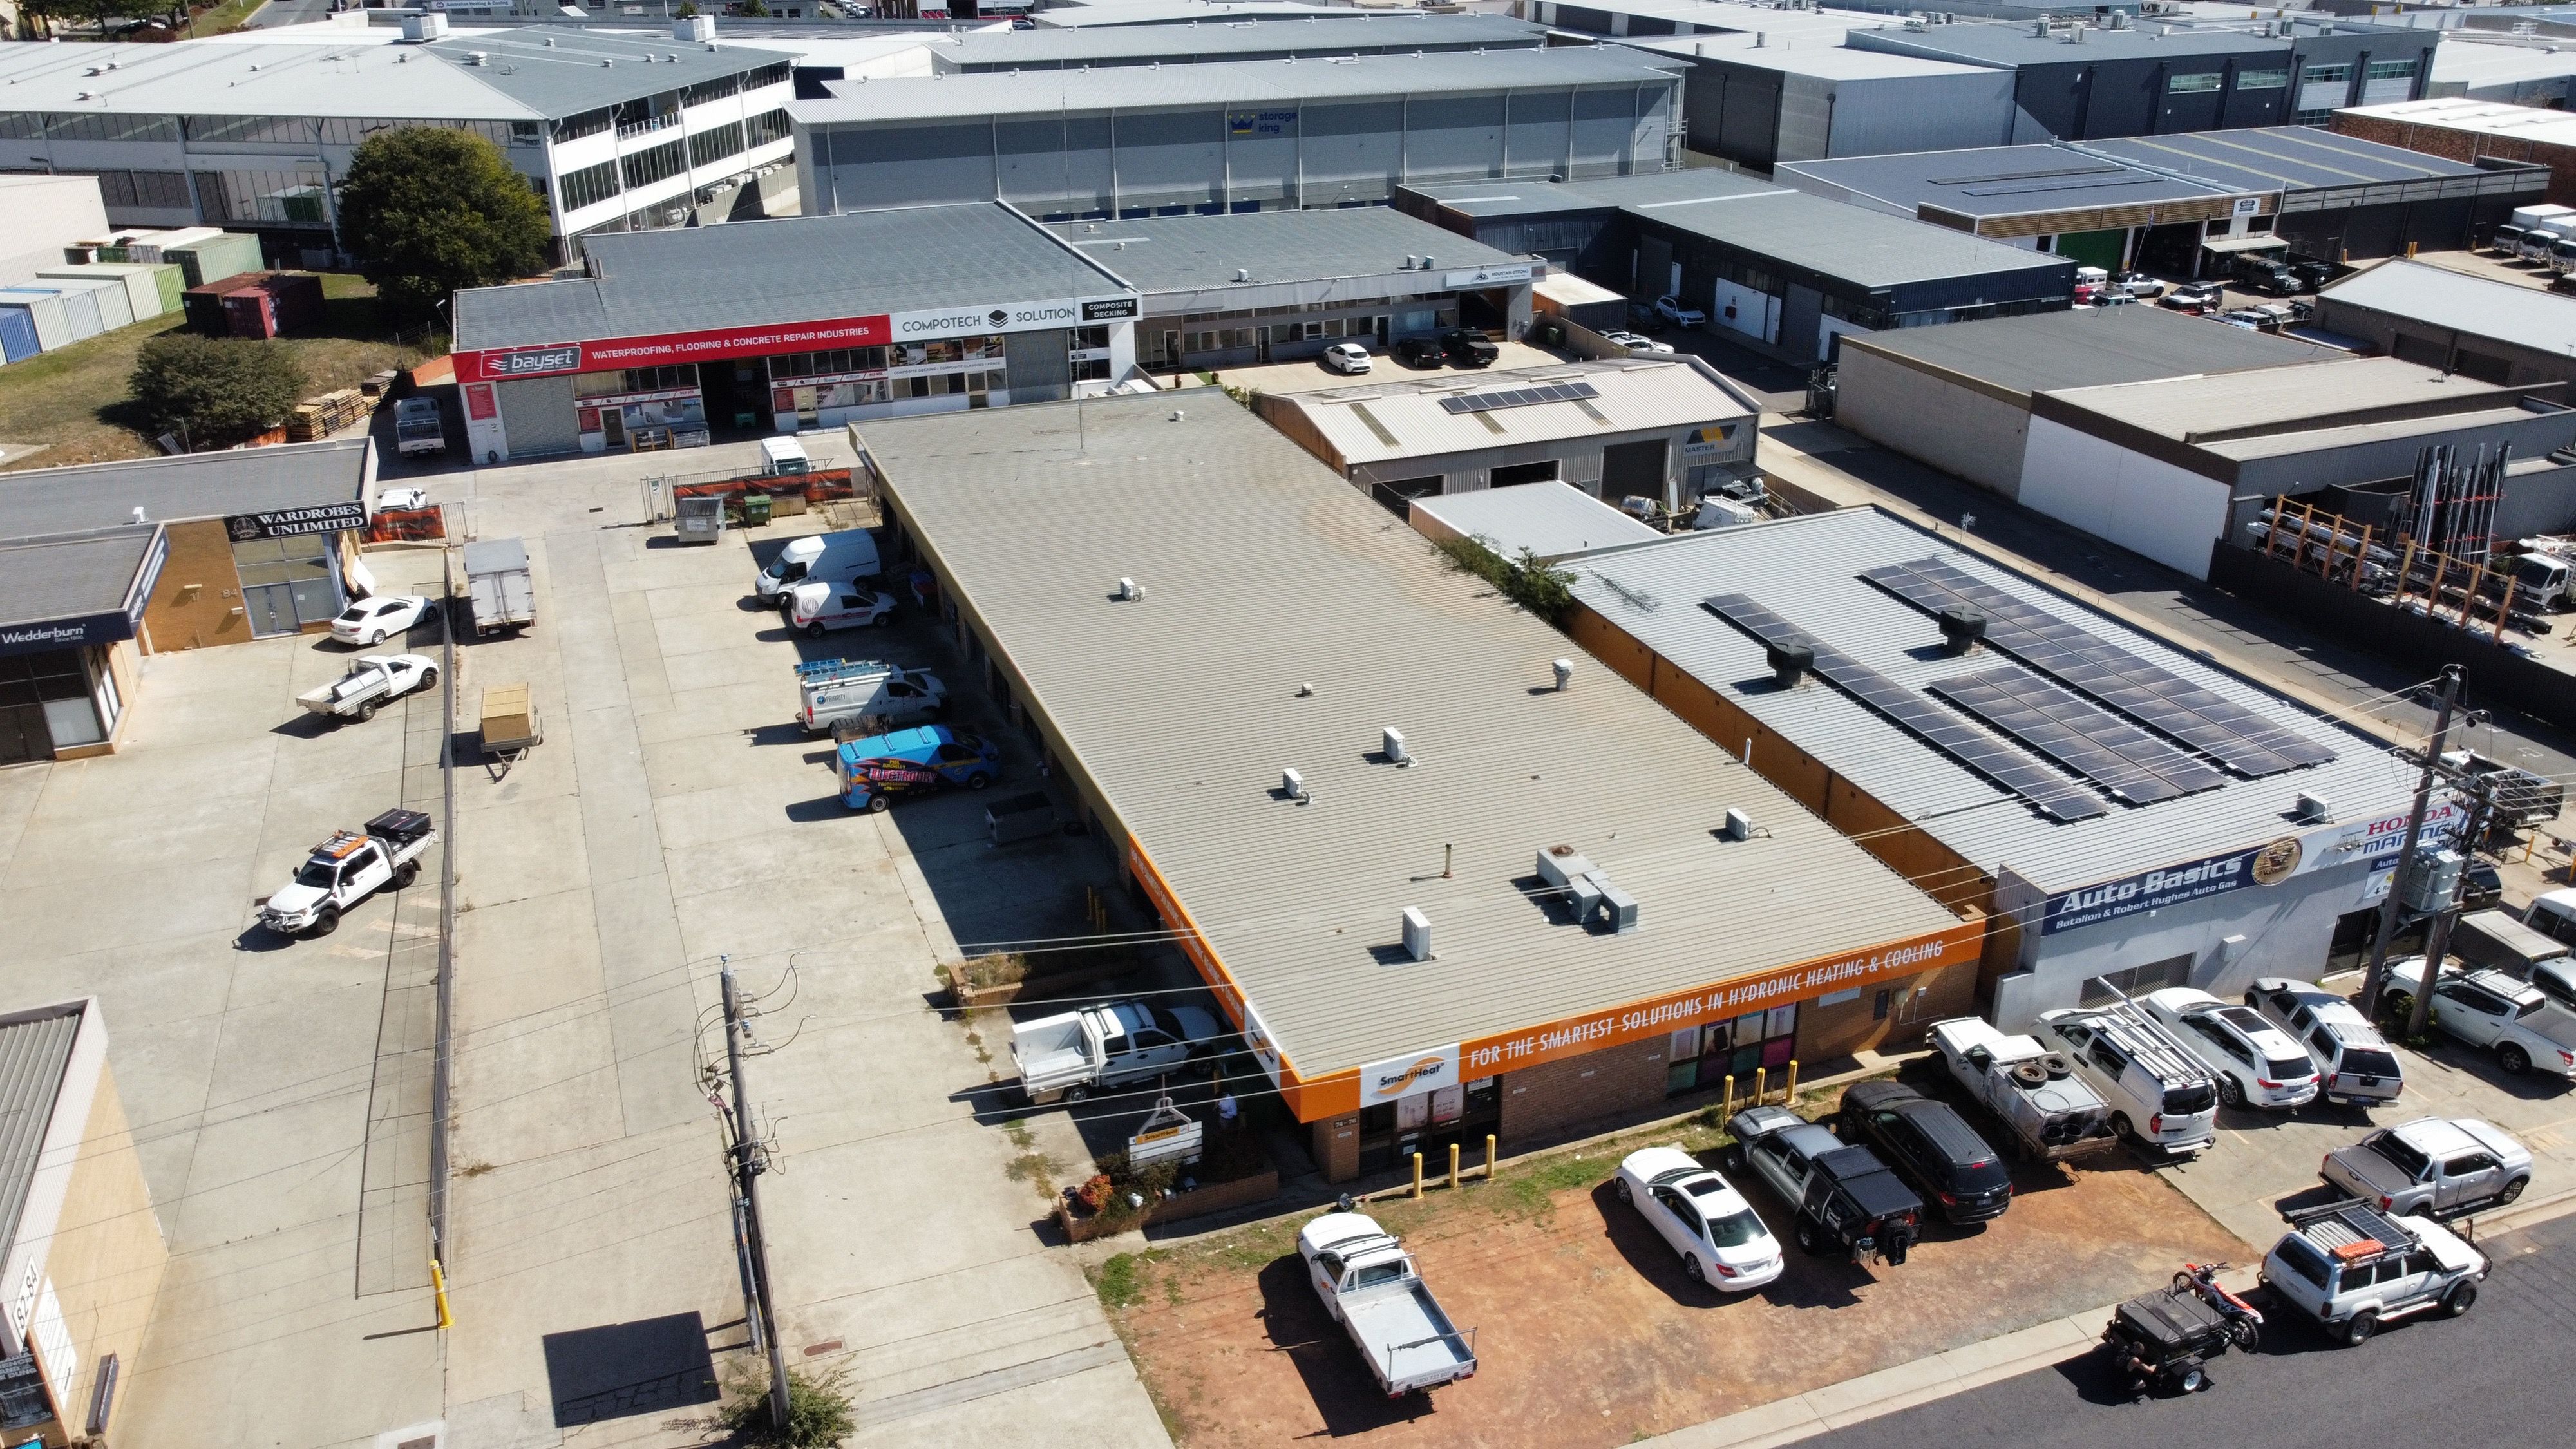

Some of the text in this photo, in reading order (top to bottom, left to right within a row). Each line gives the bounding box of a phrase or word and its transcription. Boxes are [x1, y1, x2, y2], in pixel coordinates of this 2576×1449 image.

[1259, 112, 1298, 122] storage
[1259, 123, 1280, 134] king
[1088, 301, 1132, 310] COMPOSITE
[902, 308, 1075, 332] COMPOTECH SOLUTION
[592, 327, 869, 360] WATERPROOFING, FLOORING & CONCRETE REPAIR INDUSTRIES
[512, 350, 573, 370] bayset
[1685, 444, 1715, 453] MASTER
[258, 505, 361, 524] WARDROBES
[267, 517, 364, 536] UNLIMITED
[1, 627, 84, 643] Wedderburn
[2060, 857, 2243, 913] Auto Basics
[2056, 880, 2237, 929] Batalion & Robert Hughes Auto Gas
[1471, 940, 1944, 1068] FOR THE SMARTEST SOLUTIONS IN HYDRONIC HEATING & COOLING
[1380, 1063, 1441, 1086] SmartHeat
[17, 1265, 37, 1329] 82-84
